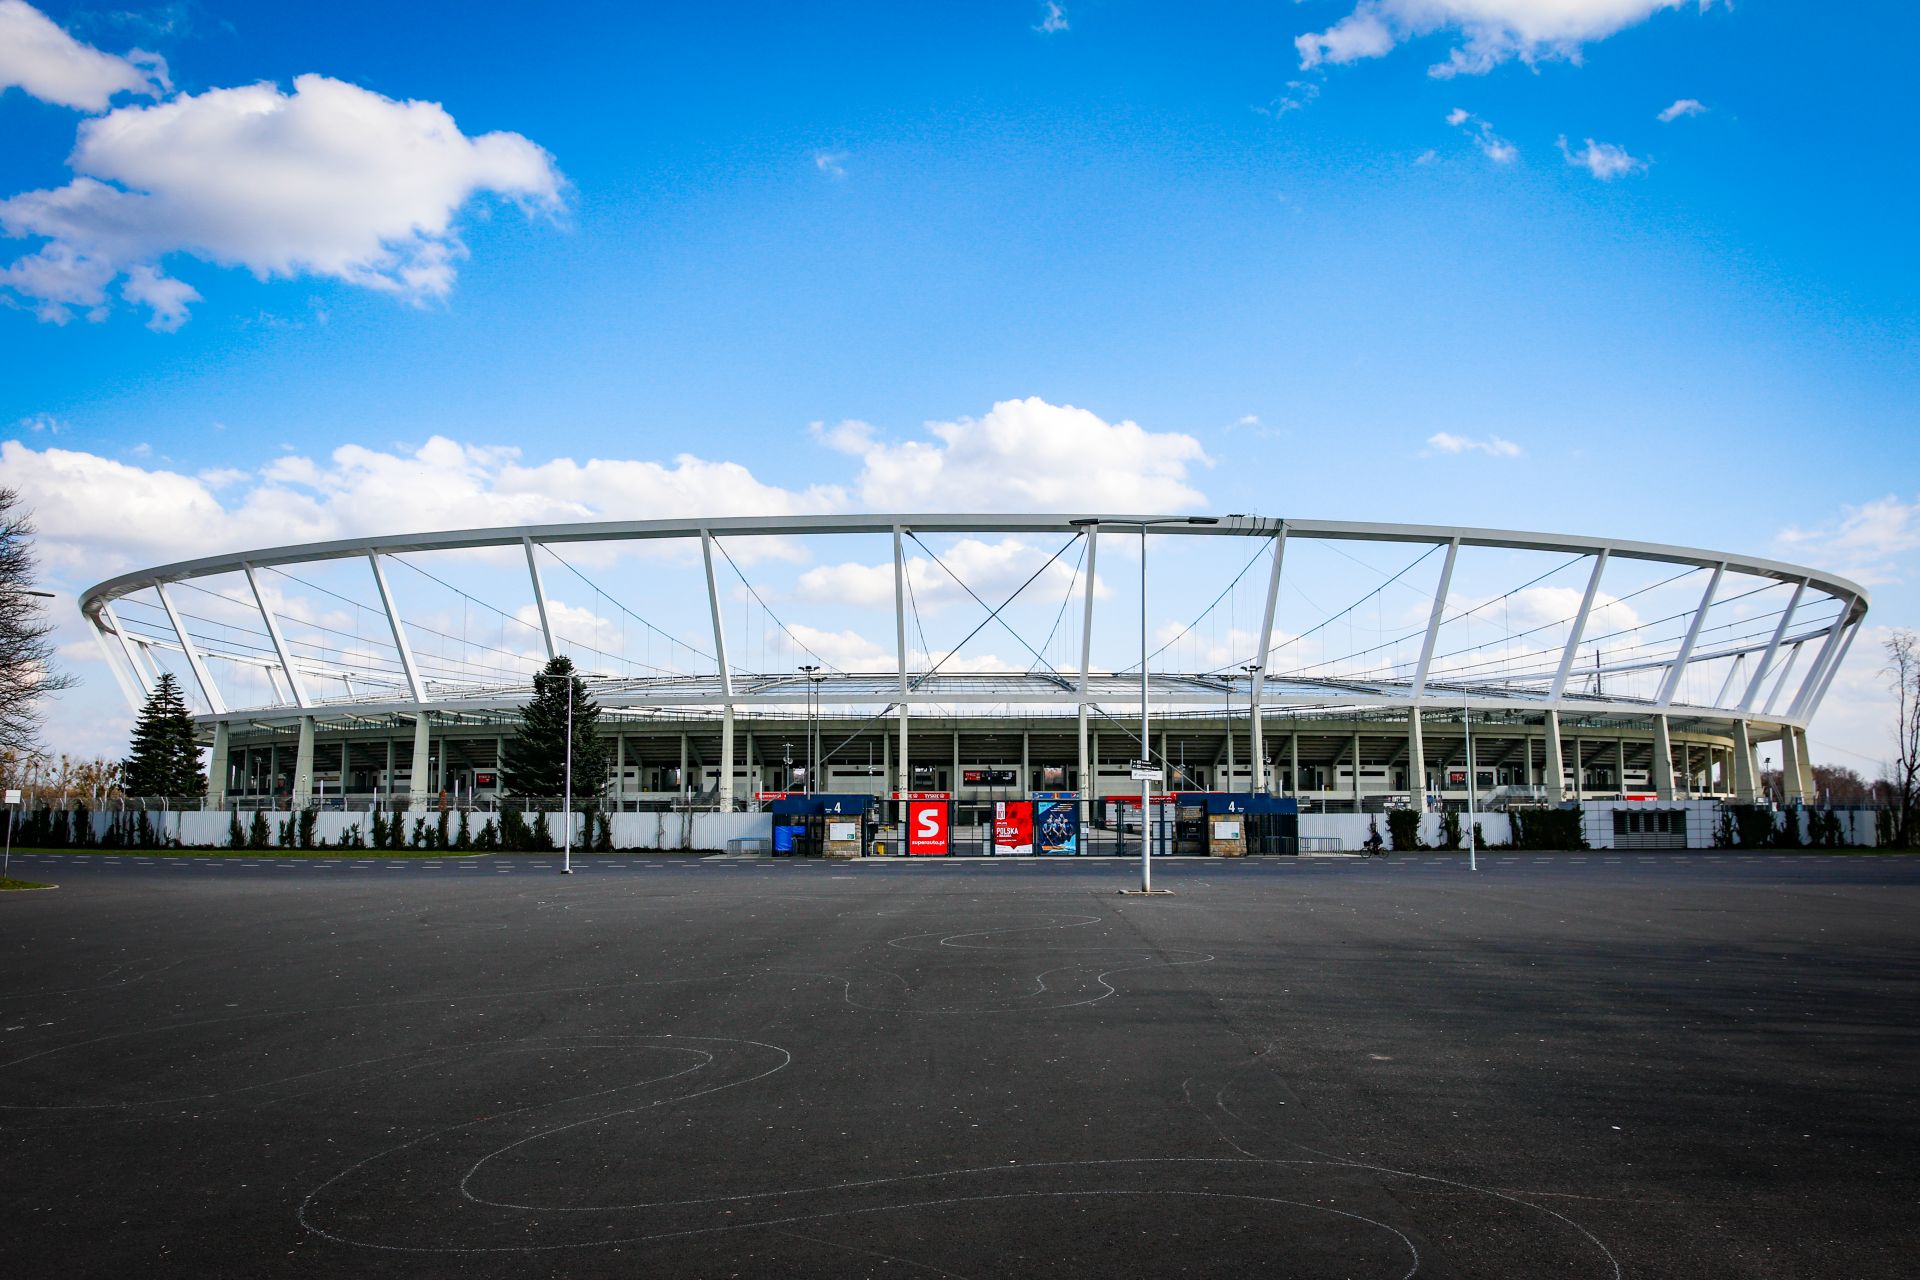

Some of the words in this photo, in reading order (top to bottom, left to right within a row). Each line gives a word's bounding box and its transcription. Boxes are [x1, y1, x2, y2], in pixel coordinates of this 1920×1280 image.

[834, 802, 842, 813] 4
[1228, 801, 1235, 812] 4
[918, 809, 939, 837] S
